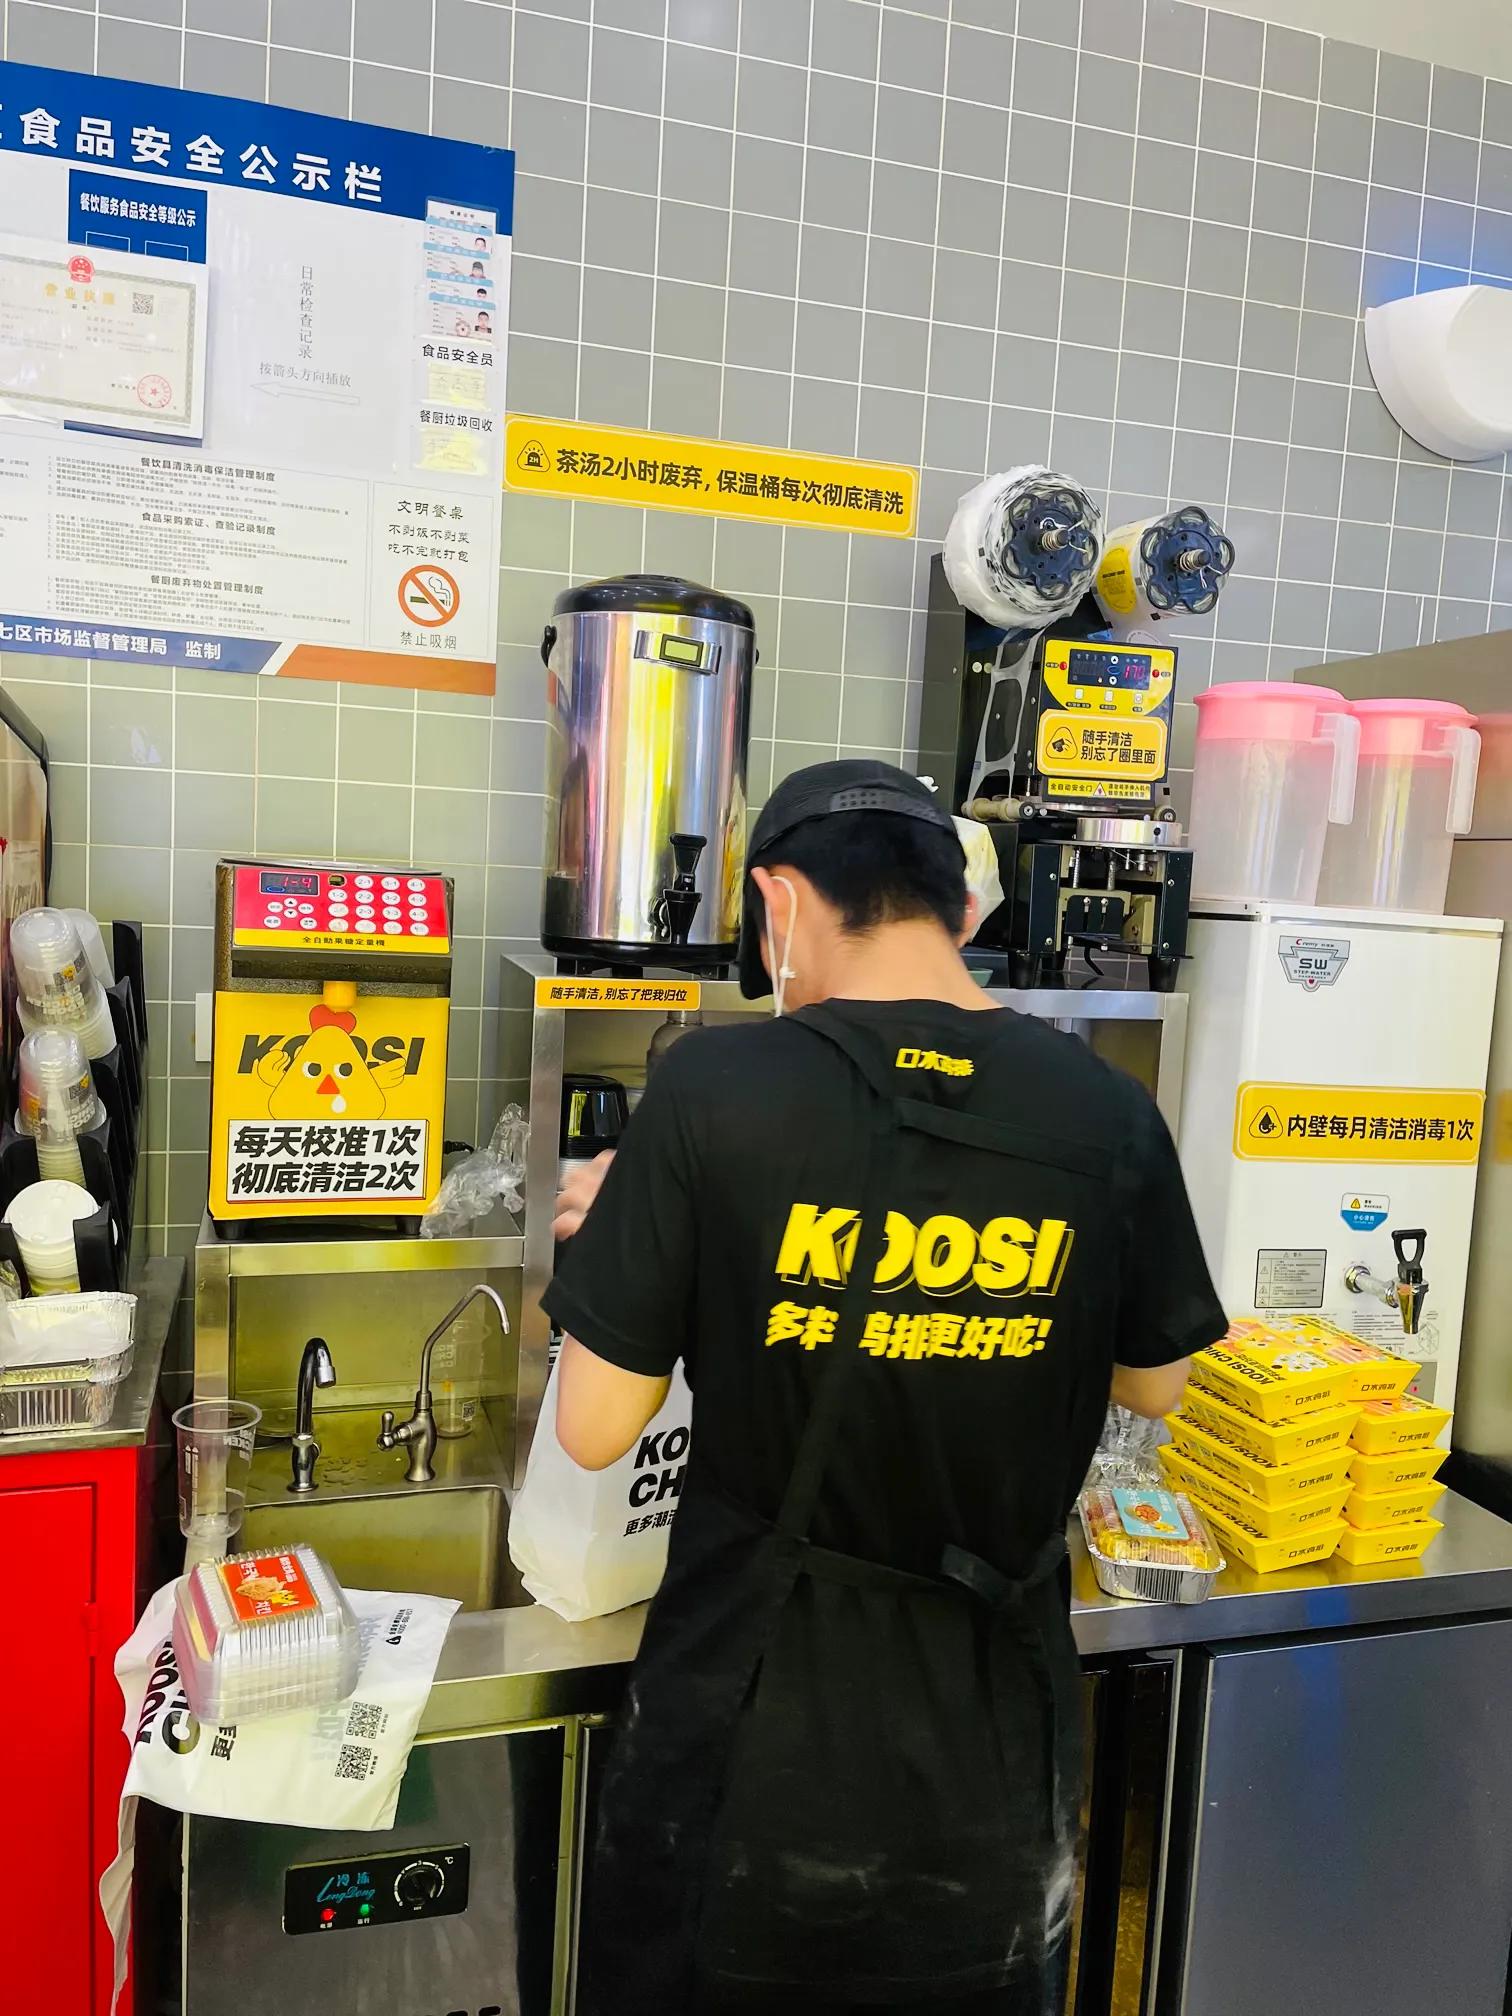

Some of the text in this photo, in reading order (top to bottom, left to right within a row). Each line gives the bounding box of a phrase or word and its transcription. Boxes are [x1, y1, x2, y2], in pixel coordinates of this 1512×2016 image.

[0, 104, 383, 203] 食品安全公示栏
[79, 191, 197, 229] 餐饮服务食品安全等级公示
[300, 265, 314, 360] 日常检查记录
[422, 343, 493, 367] 食品安全员
[420, 409, 493, 432] 餐厨垃圾回收
[397, 500, 463, 520] 文明餐桌
[388, 524, 470, 544] 不剩饭不剩菜
[388, 543, 469, 563] 吃不完就打包
[184, 640, 221, 660] 监制
[400, 631, 456, 650] 禁止吸烟
[1082, 729, 1133, 748] 随手清洁
[1080, 745, 1157, 765] 别忘了圈里面
[1299, 958, 1328, 970] SW
[550, 986, 687, 1002] 随手清洁，别忘了把我归位
[1287, 1114, 1475, 1141] 内壁每月清洁消毒1次
[232, 1125, 422, 1158] 每天校准1次
[231, 1160, 419, 1194] 彻底清洁2次
